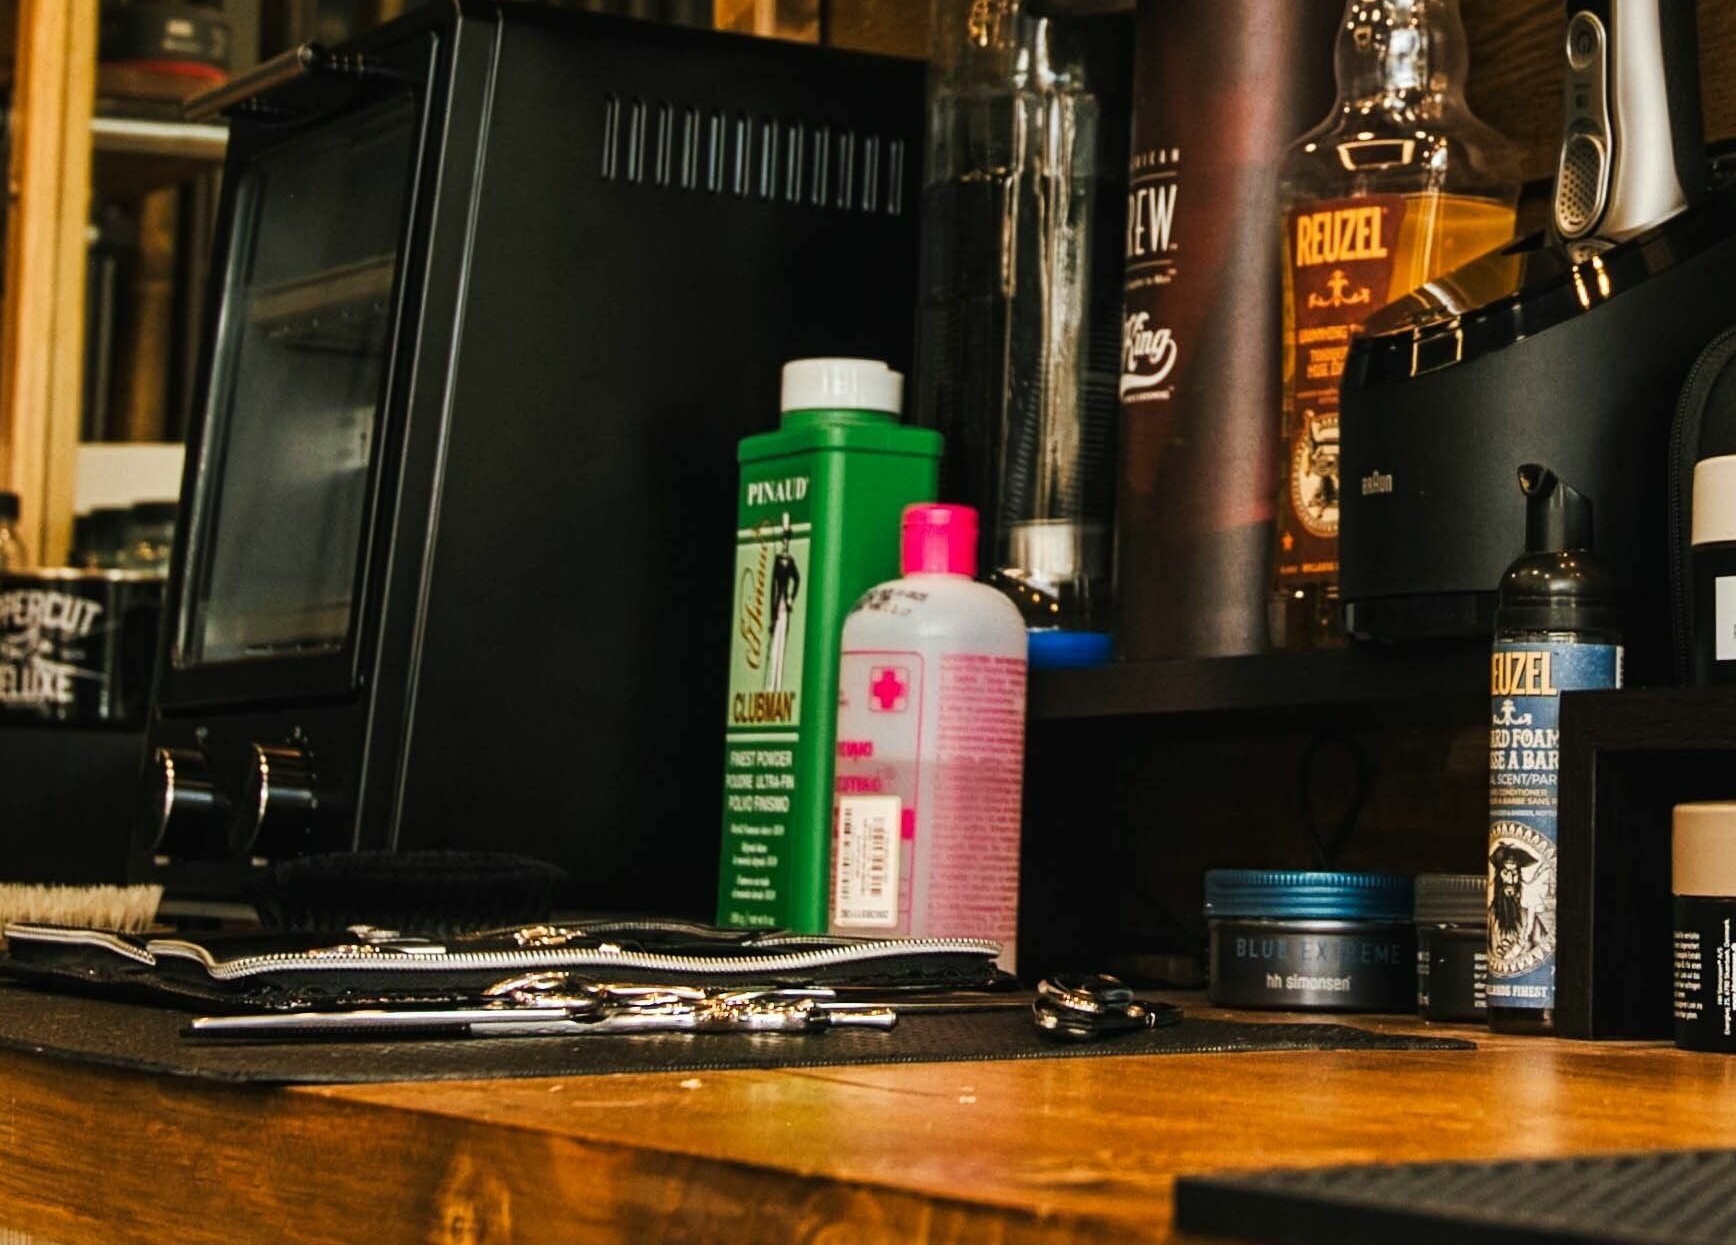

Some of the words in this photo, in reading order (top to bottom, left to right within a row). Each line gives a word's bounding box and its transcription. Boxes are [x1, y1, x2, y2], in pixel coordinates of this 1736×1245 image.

[1296, 205, 1389, 268] REUZEL
[746, 477, 807, 506] PINAUD
[732, 691, 794, 724] CLUBMAN
[1235, 937, 1288, 959] BLUE
[1300, 941, 1401, 965] EXTREME
[1265, 973, 1283, 990] hh
[1285, 974, 1350, 992] simonsen
[1511, 985, 1548, 998] FINEST
